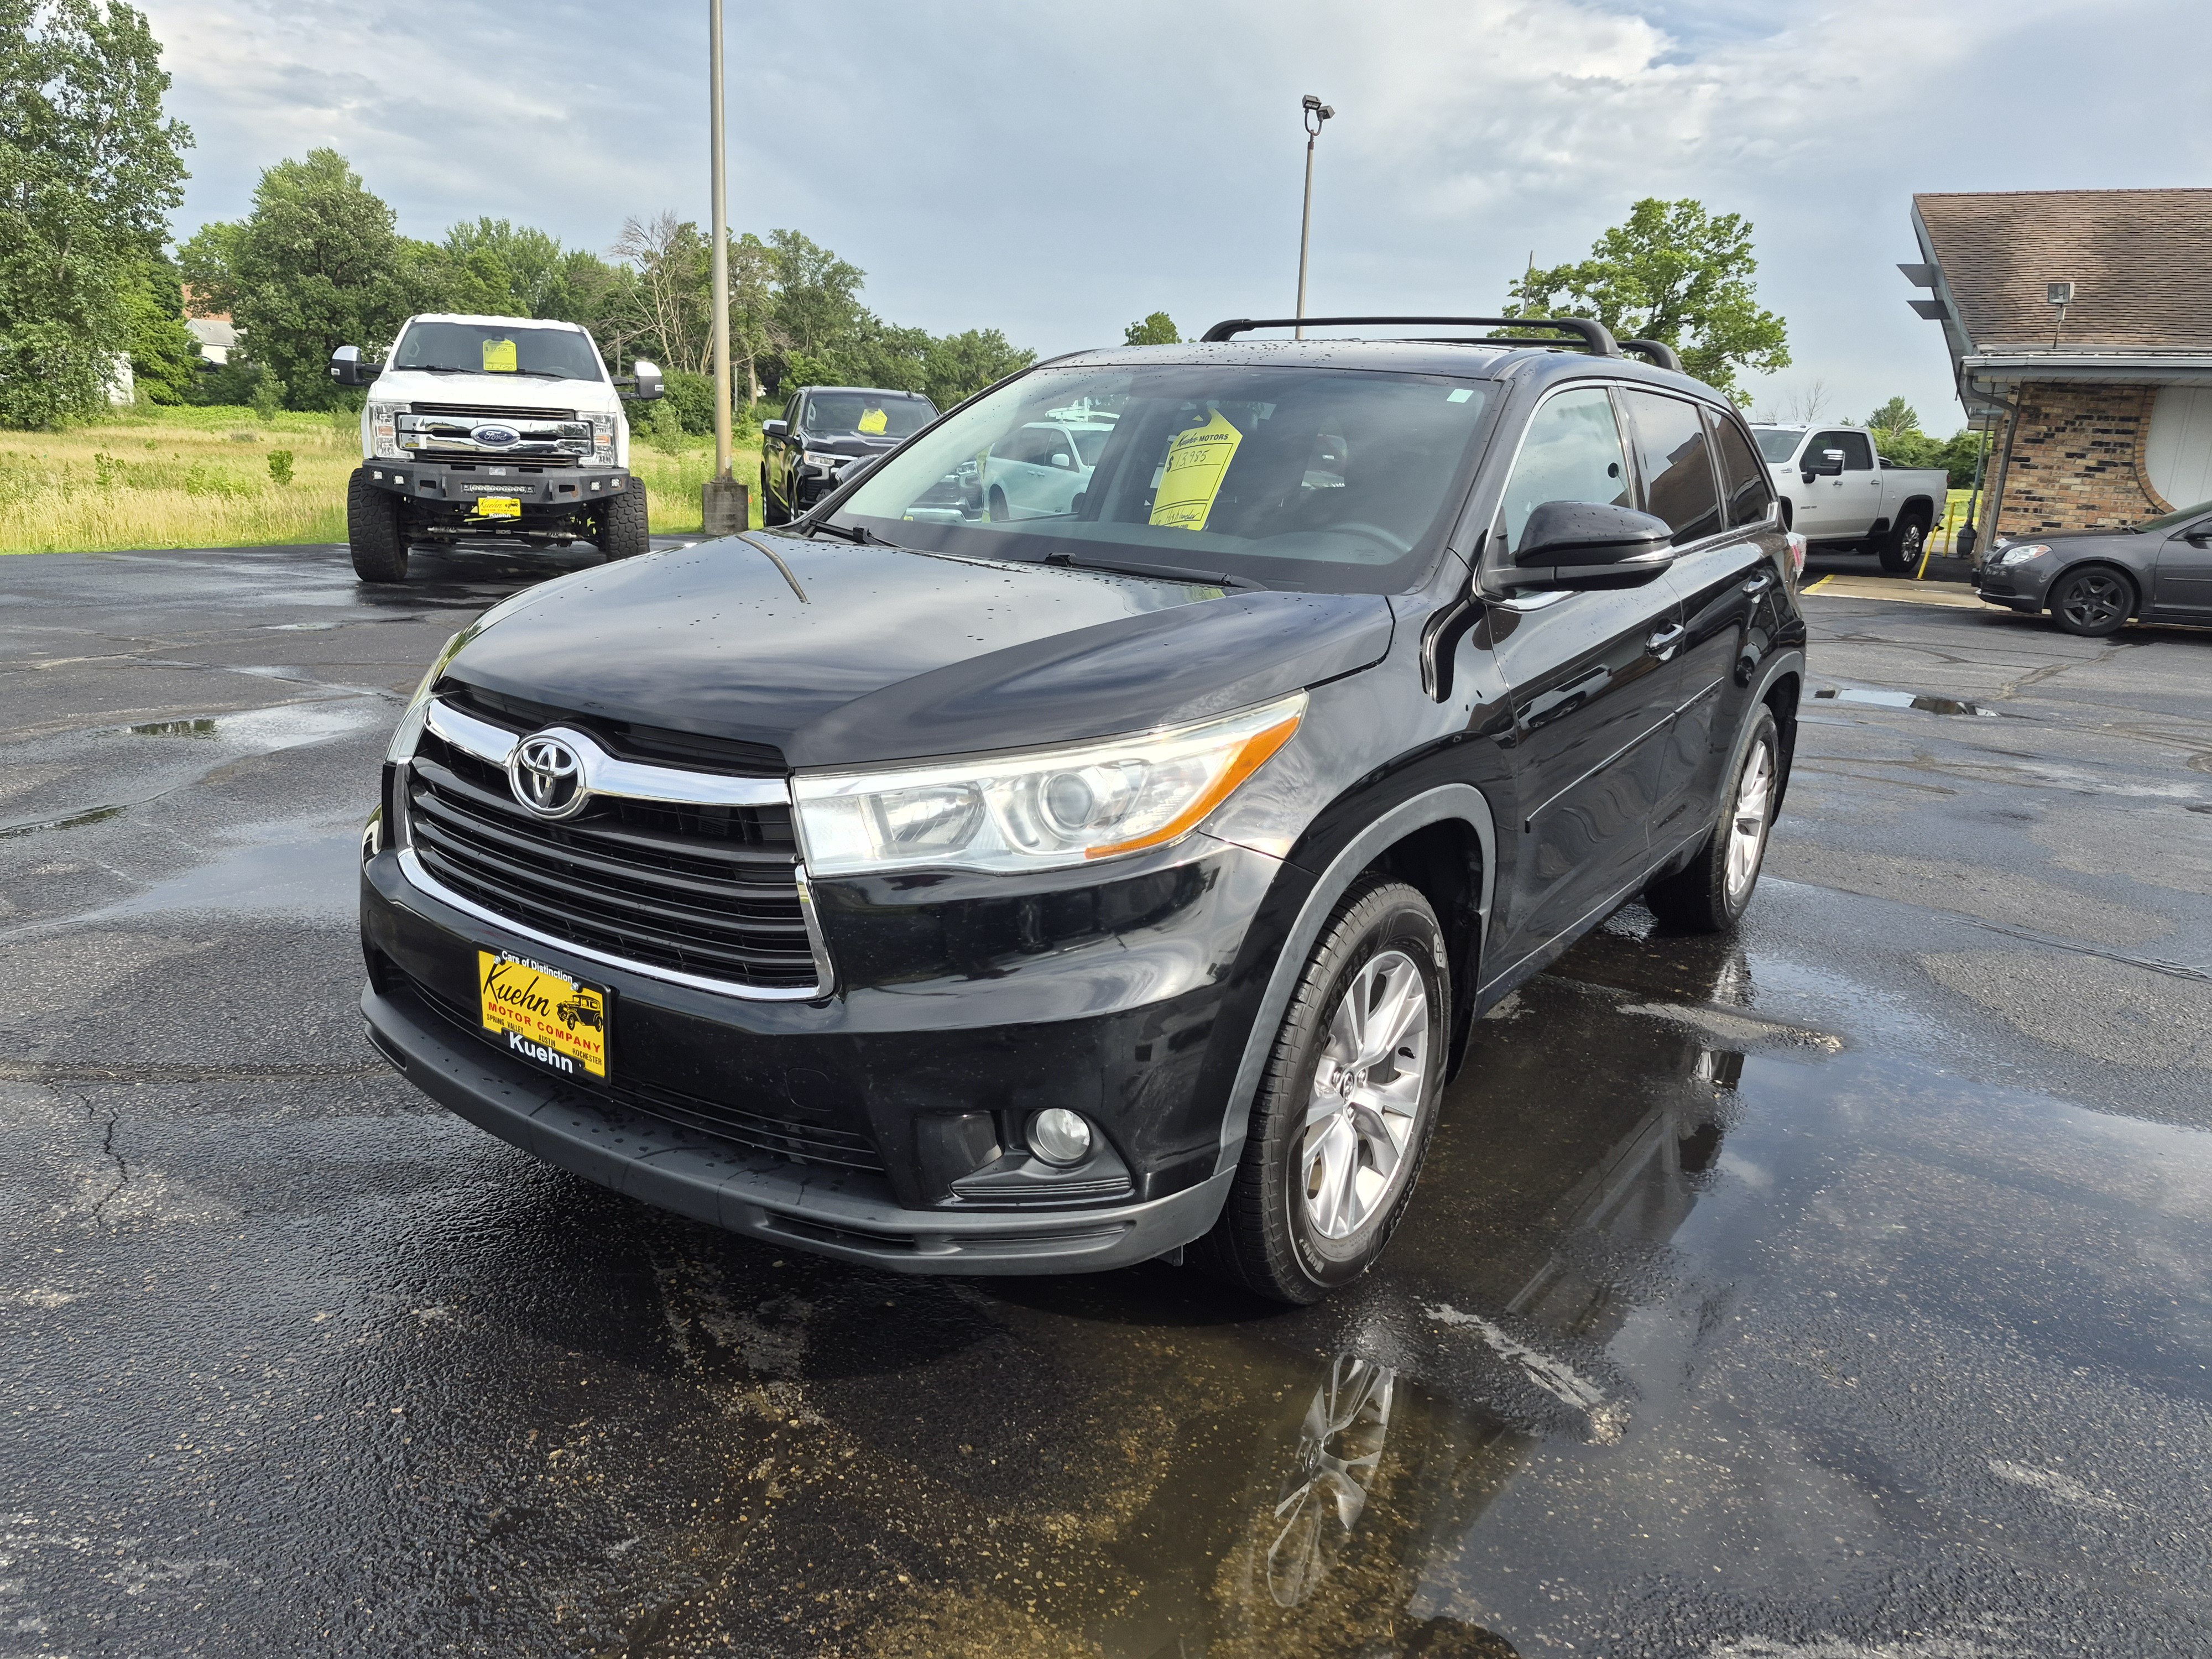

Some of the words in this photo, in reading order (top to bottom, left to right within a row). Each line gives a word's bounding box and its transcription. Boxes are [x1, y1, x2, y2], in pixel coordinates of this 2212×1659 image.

[484, 431, 507, 441] Ford
[1199, 434, 1229, 442] MOTORS
[1166, 456, 1174, 473] $
[502, 950, 520, 964] Cars
[521, 958, 530, 968] of
[531, 960, 573, 984] Distinction
[483, 963, 550, 1017] Kuehn
[487, 1014, 505, 1026] SPRING
[507, 1022, 524, 1034] VALLEY
[538, 1034, 556, 1047] AUSTIN
[572, 1048, 602, 1066] ROCHESTER
[488, 1002, 532, 1026] MOTOR
[537, 1021, 601, 1053] COMPANY
[510, 1032, 573, 1073] Kuehn
